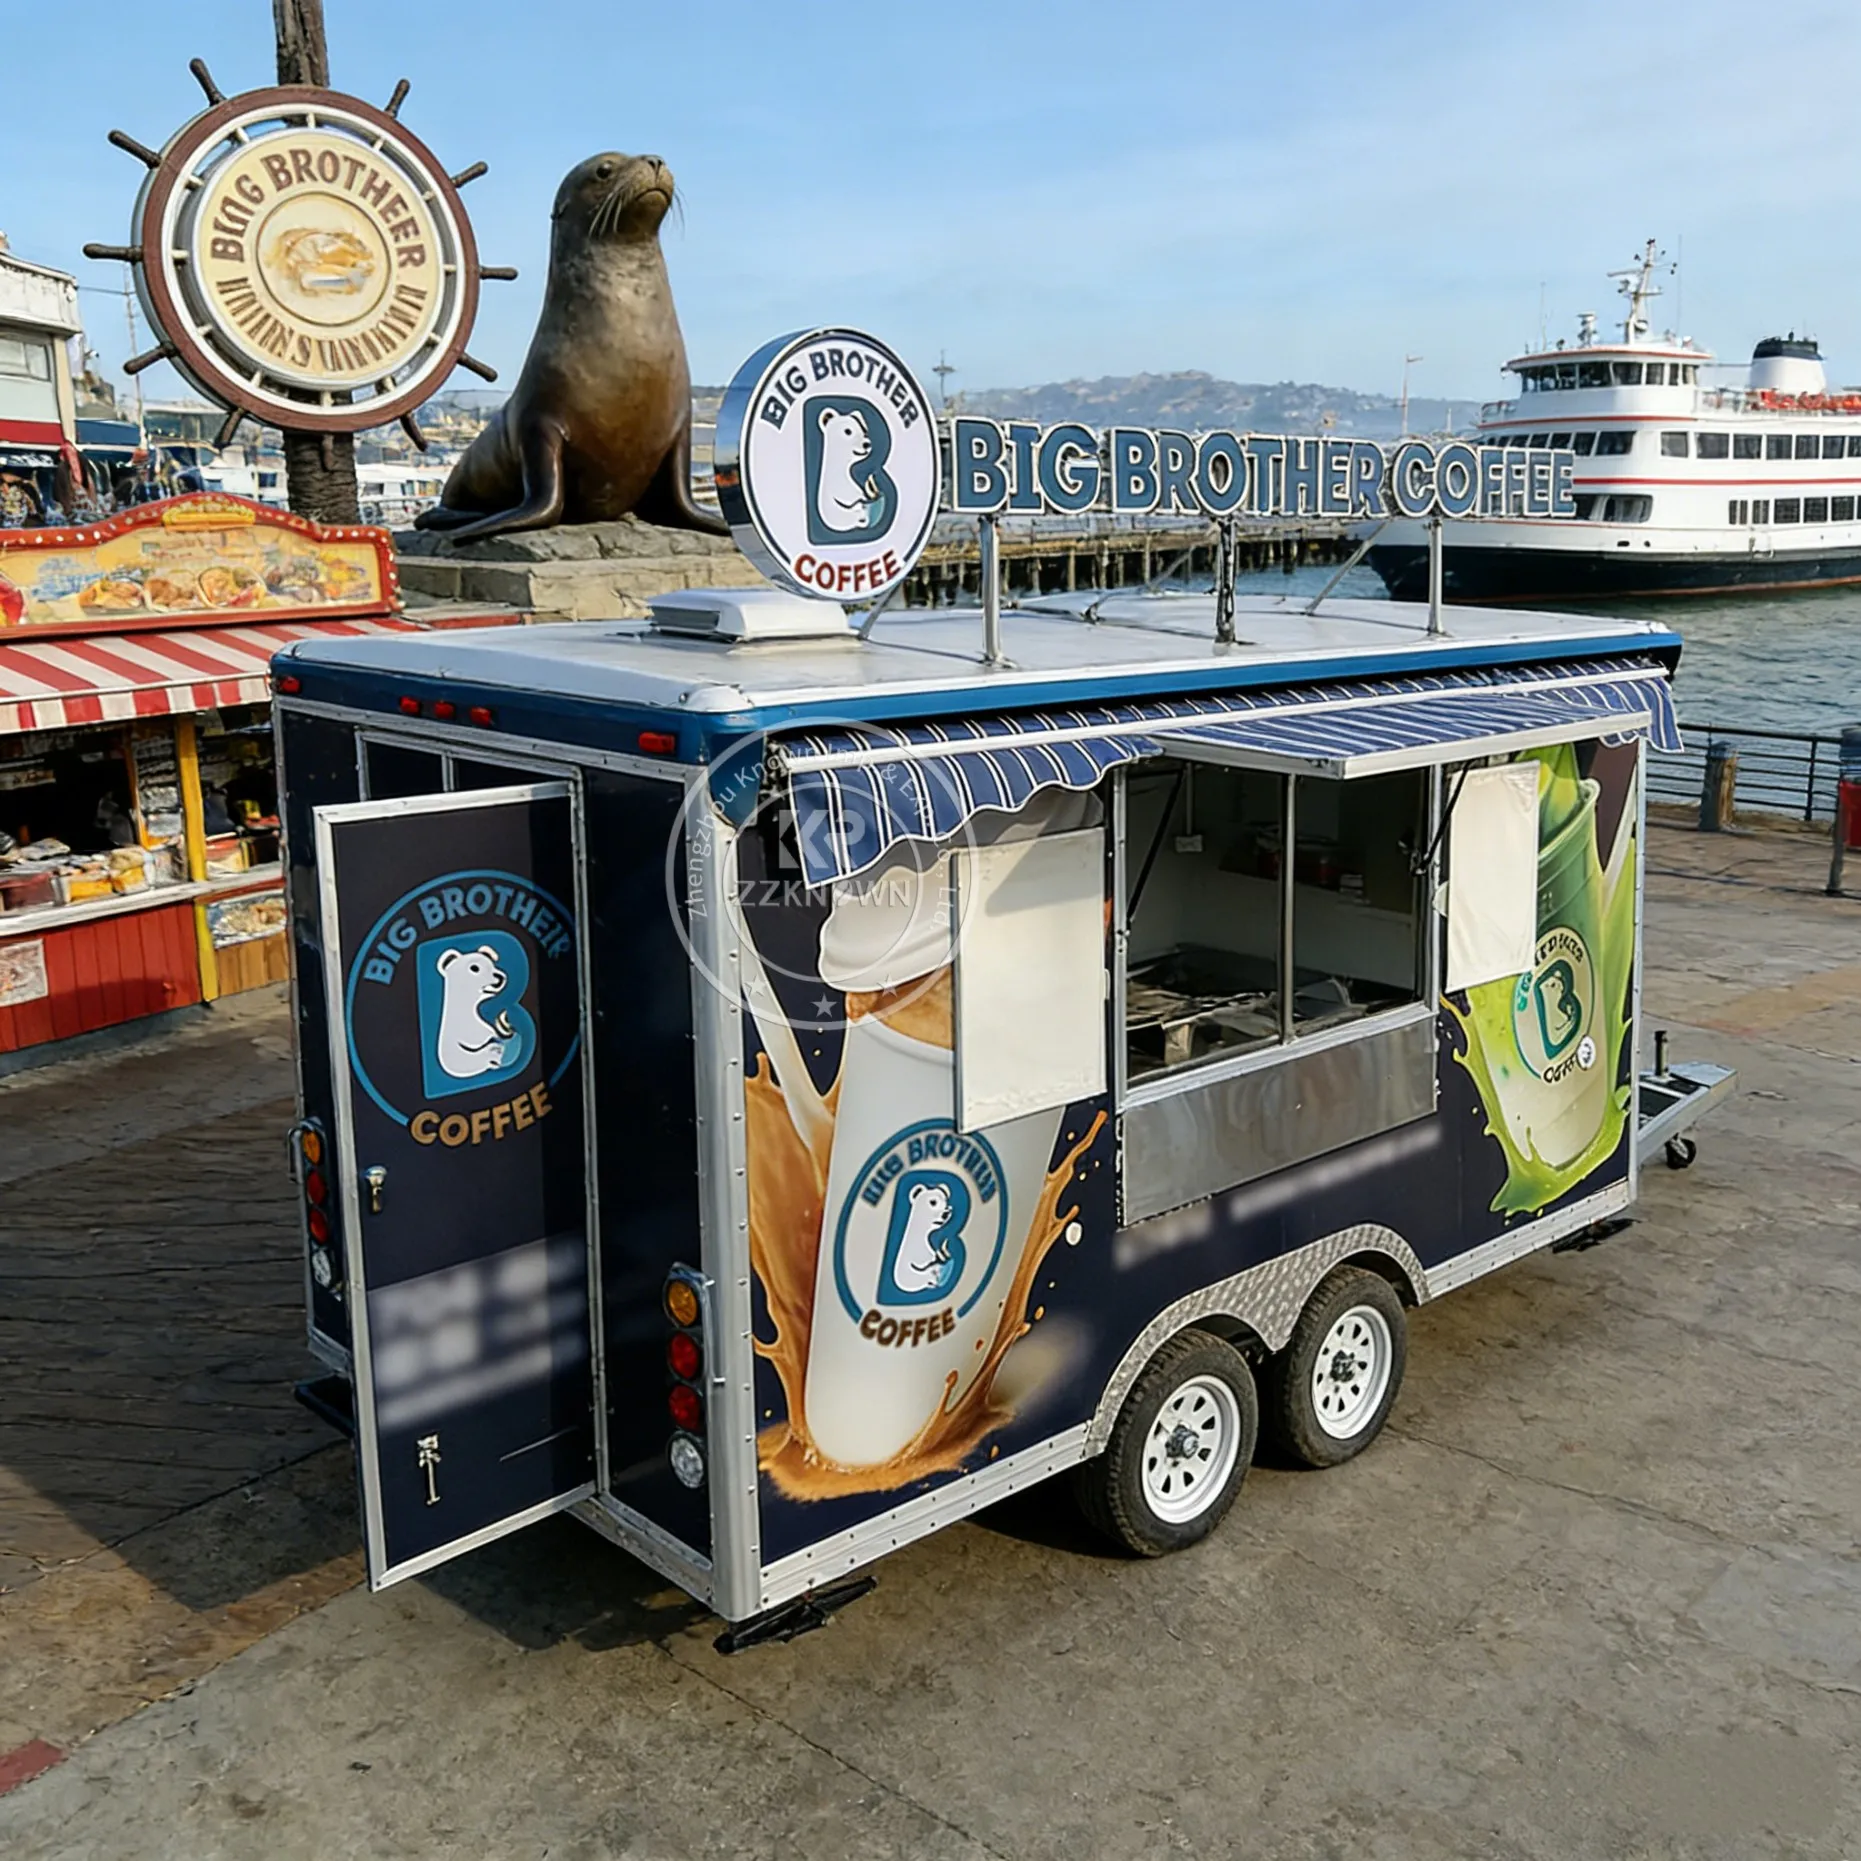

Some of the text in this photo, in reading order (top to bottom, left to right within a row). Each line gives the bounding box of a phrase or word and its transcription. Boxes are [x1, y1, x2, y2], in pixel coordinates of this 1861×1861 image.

[761, 348, 919, 430] BIG BROTHER
[952, 416, 1577, 518] BIG BROTHER COFFEE
[794, 550, 901, 592] COFFEE
[364, 883, 572, 985] BIG BROTHER
[409, 1082, 553, 1147] COFFEE
[860, 1307, 956, 1349] COFFEE
